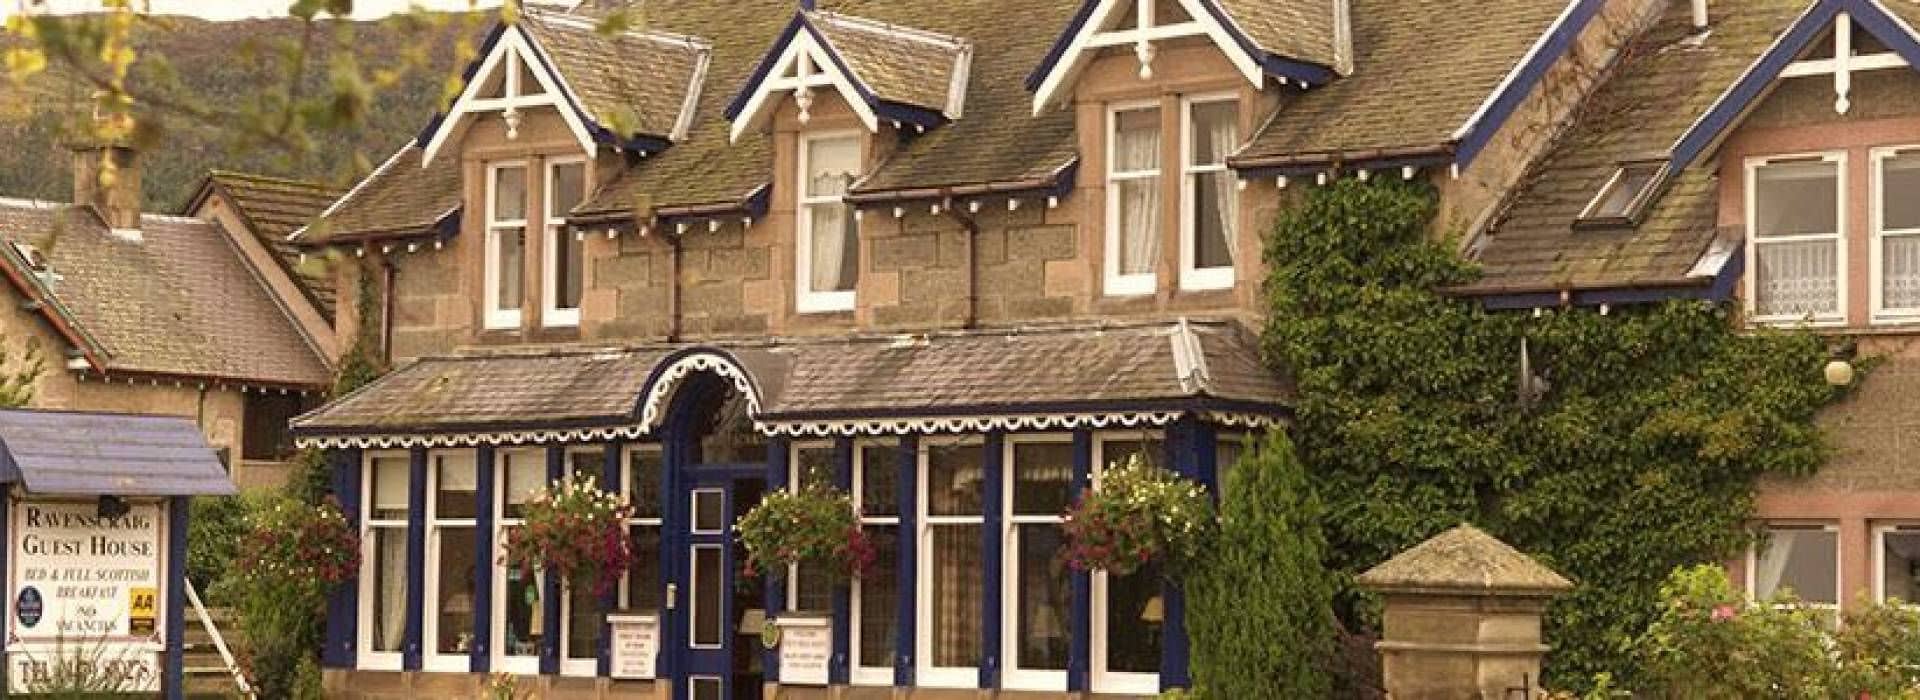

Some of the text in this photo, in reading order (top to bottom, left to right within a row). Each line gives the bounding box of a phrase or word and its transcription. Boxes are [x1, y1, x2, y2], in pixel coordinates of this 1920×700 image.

[22, 533, 153, 557] GUEST HOUSE
[132, 594, 153, 609] AA
